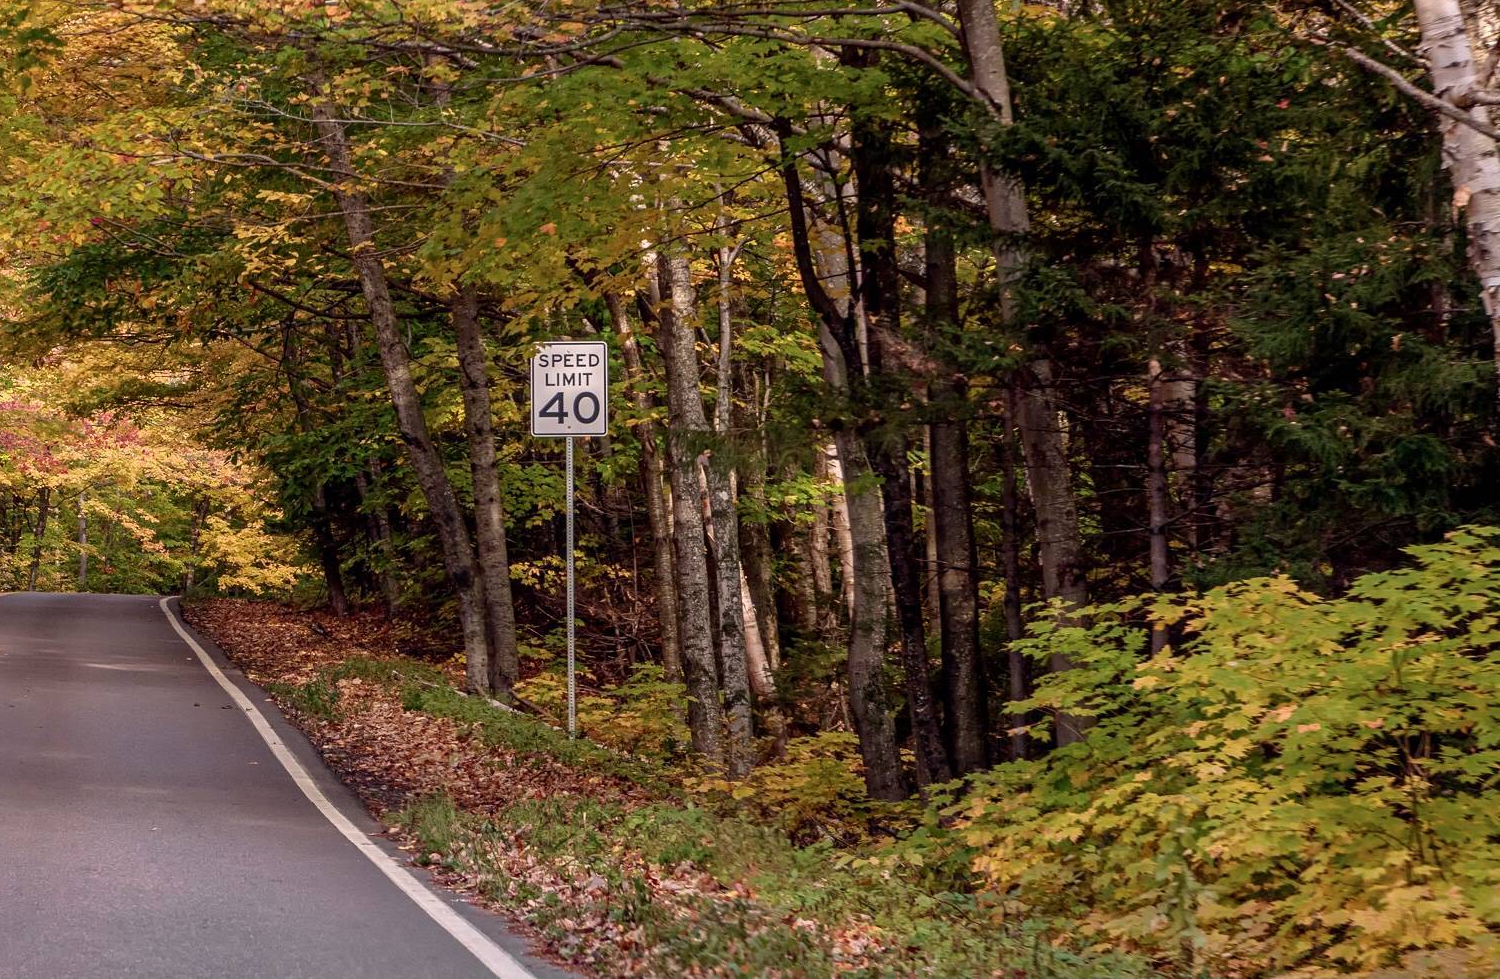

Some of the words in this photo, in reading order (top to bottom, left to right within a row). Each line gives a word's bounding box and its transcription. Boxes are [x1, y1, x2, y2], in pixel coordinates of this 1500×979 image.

[538, 354, 600, 368] SPEED
[545, 373, 593, 386] LIMIT
[538, 391, 600, 424] 40
